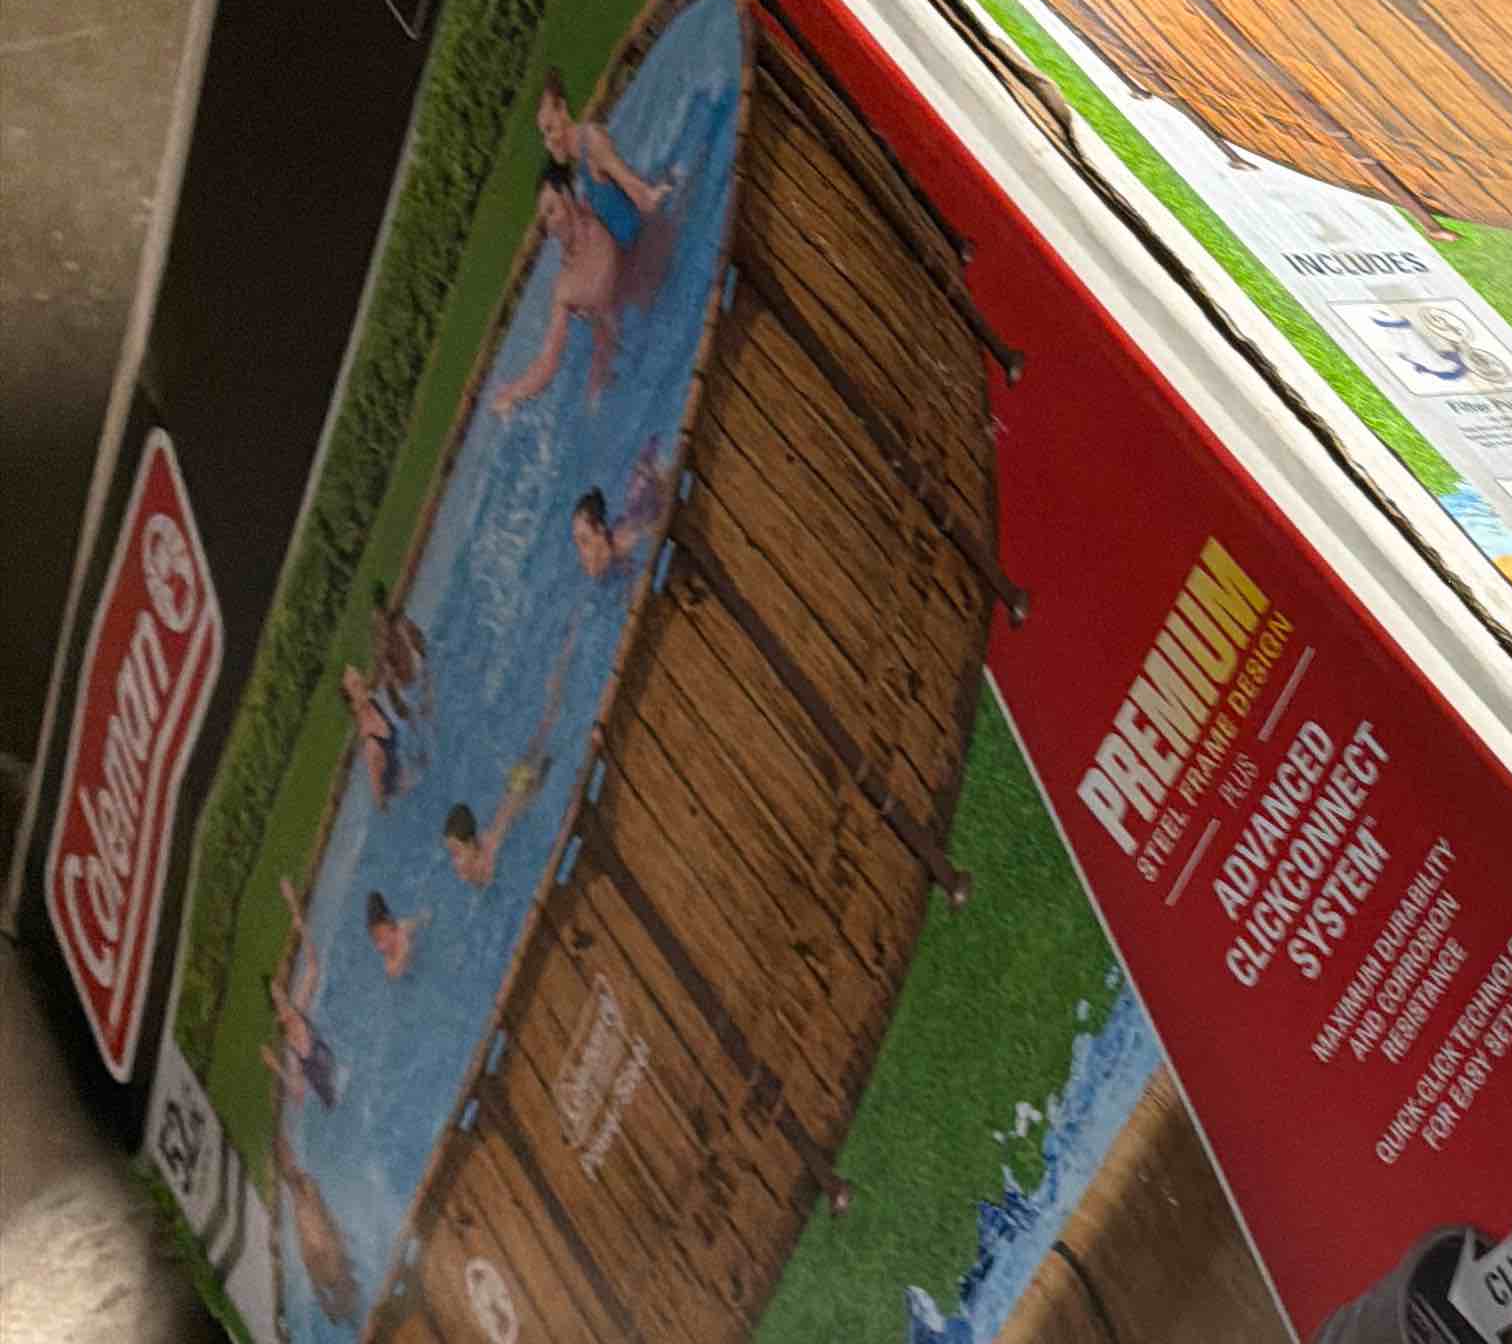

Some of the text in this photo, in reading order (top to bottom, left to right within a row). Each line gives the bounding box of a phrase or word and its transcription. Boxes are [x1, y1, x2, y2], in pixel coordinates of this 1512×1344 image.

[1281, 252, 1430, 275] INCLUDES
[1076, 531, 1270, 861] PREMIUM
[1137, 607, 1294, 886] STEEL FRAME DESIGN
[1218, 747, 1260, 813] PLUS
[61, 610, 171, 987] Coleman
[1211, 712, 1337, 921] ADVANCED
[1222, 716, 1394, 995] CLICKCONNECT
[1311, 834, 1458, 1066] MAXIMUM DURABILITY
[1349, 887, 1460, 1064] AND CORROSION
[1380, 933, 1469, 1068] RESISTANCE
[1373, 1035, 1464, 1171] QUICK-CLICK
[1420, 1098, 1460, 1154] FOR
[1448, 1048, 1494, 1112] EASY
